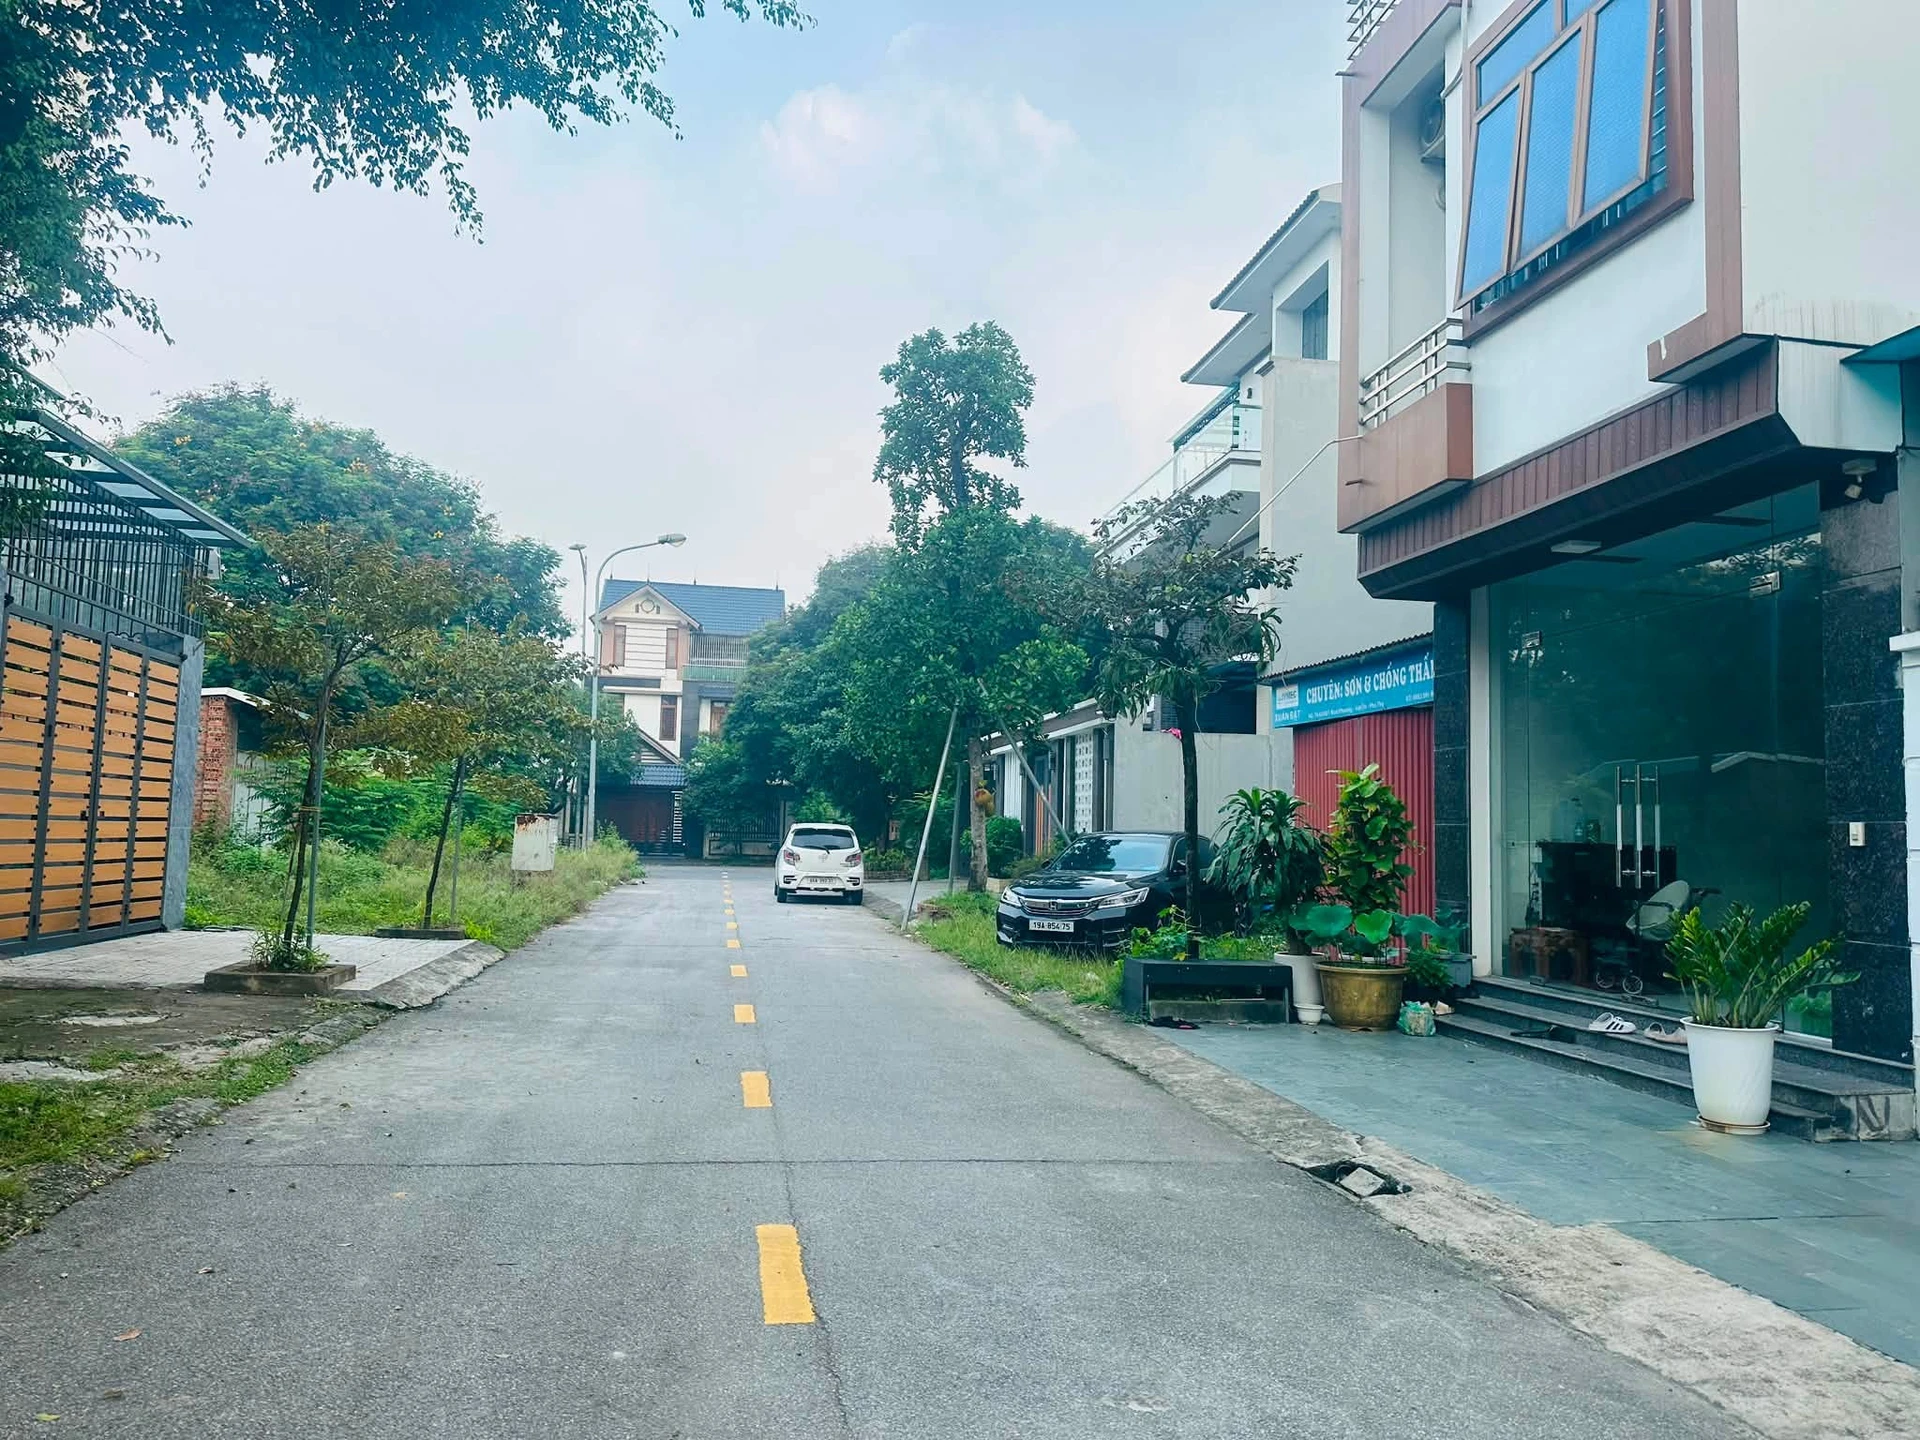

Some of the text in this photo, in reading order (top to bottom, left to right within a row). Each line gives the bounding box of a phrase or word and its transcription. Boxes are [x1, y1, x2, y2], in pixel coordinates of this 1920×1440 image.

[1306, 679, 1343, 704] CHUYÊN:
[1344, 675, 1362, 697] SƠN
[1364, 675, 1371, 693] &
[1373, 661, 1406, 691] CHỐNG
